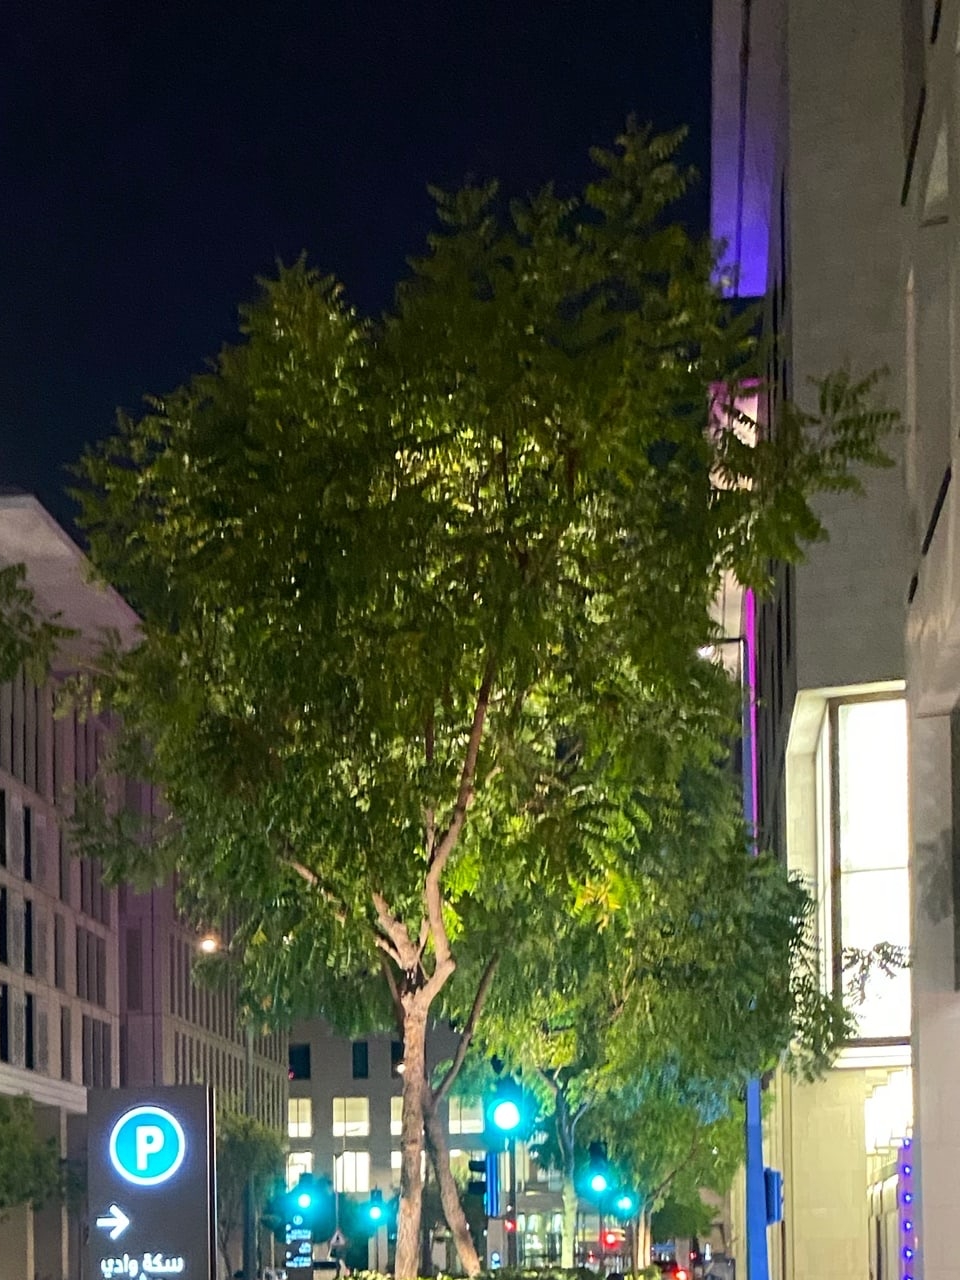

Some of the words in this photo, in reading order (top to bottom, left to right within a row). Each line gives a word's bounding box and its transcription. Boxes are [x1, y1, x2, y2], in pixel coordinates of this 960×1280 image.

[136, 1125, 165, 1171] P
[101, 1253, 139, 1278] وادي
[142, 1252, 184, 1273] سكة
